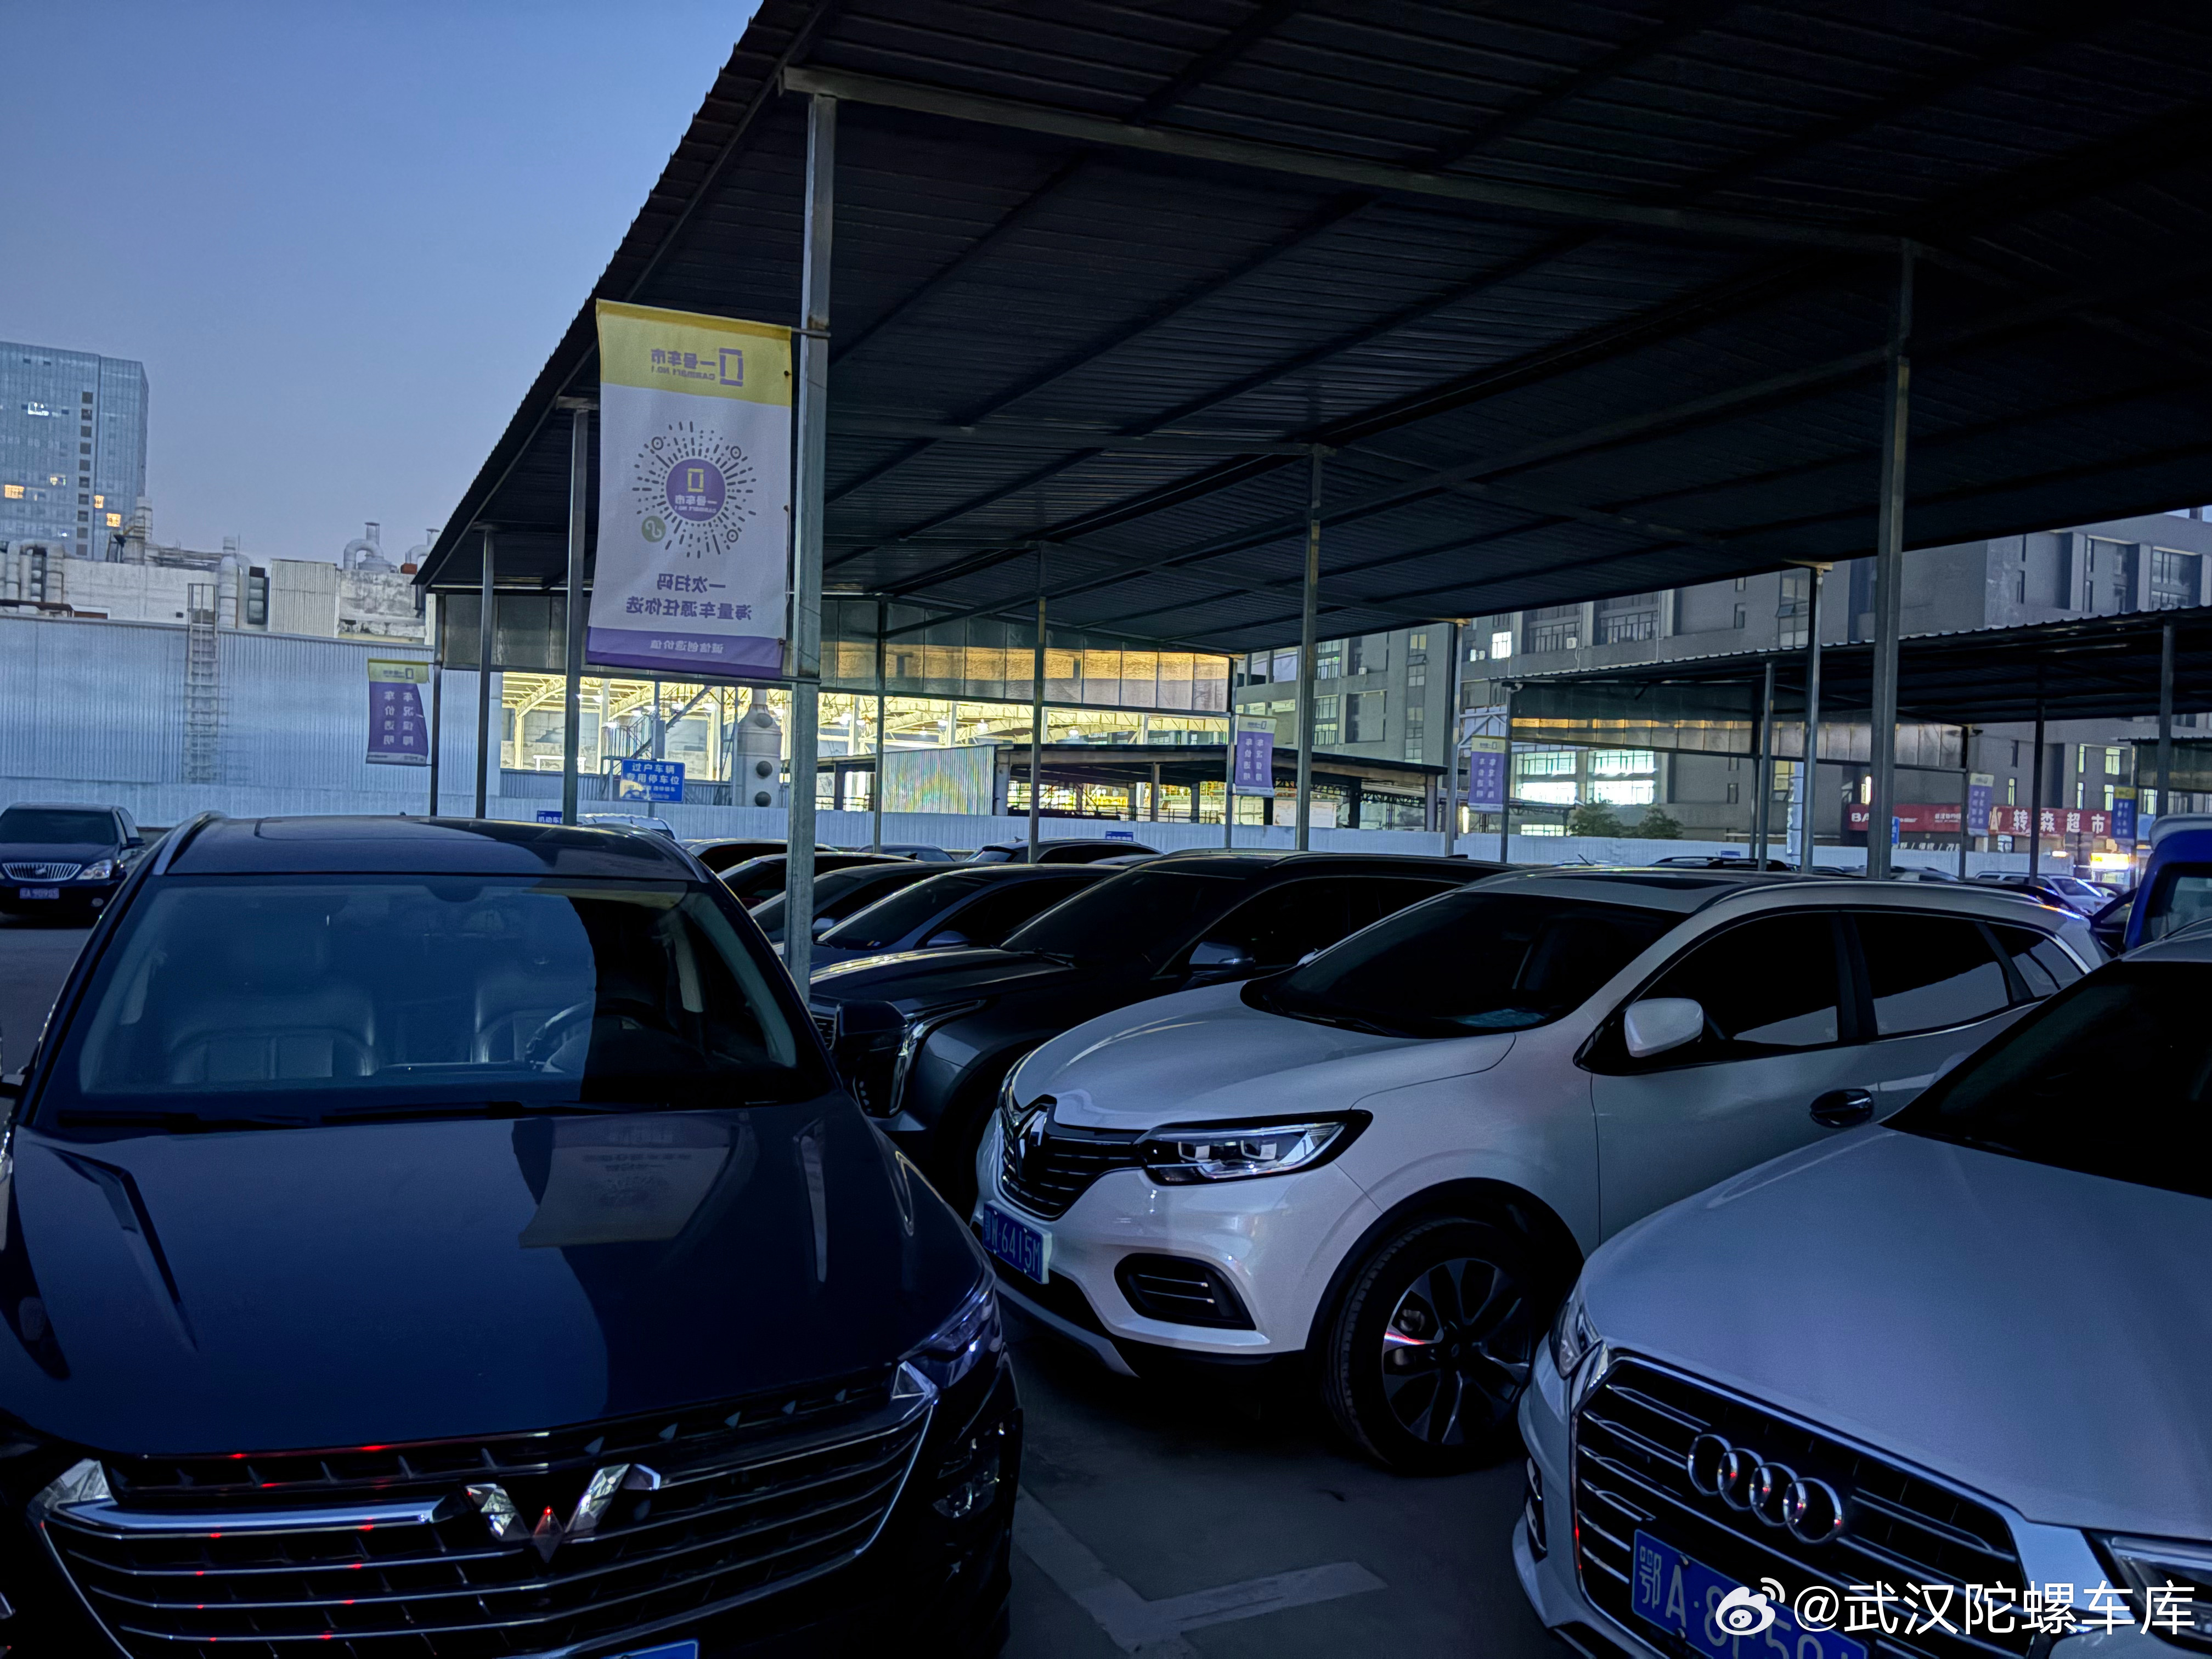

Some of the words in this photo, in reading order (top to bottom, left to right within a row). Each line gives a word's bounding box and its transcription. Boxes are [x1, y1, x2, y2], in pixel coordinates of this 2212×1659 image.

[632, 762, 675, 775] 过户车辆
[626, 772, 680, 785] 专用停车位
[2013, 809, 2106, 834] 转森超市
